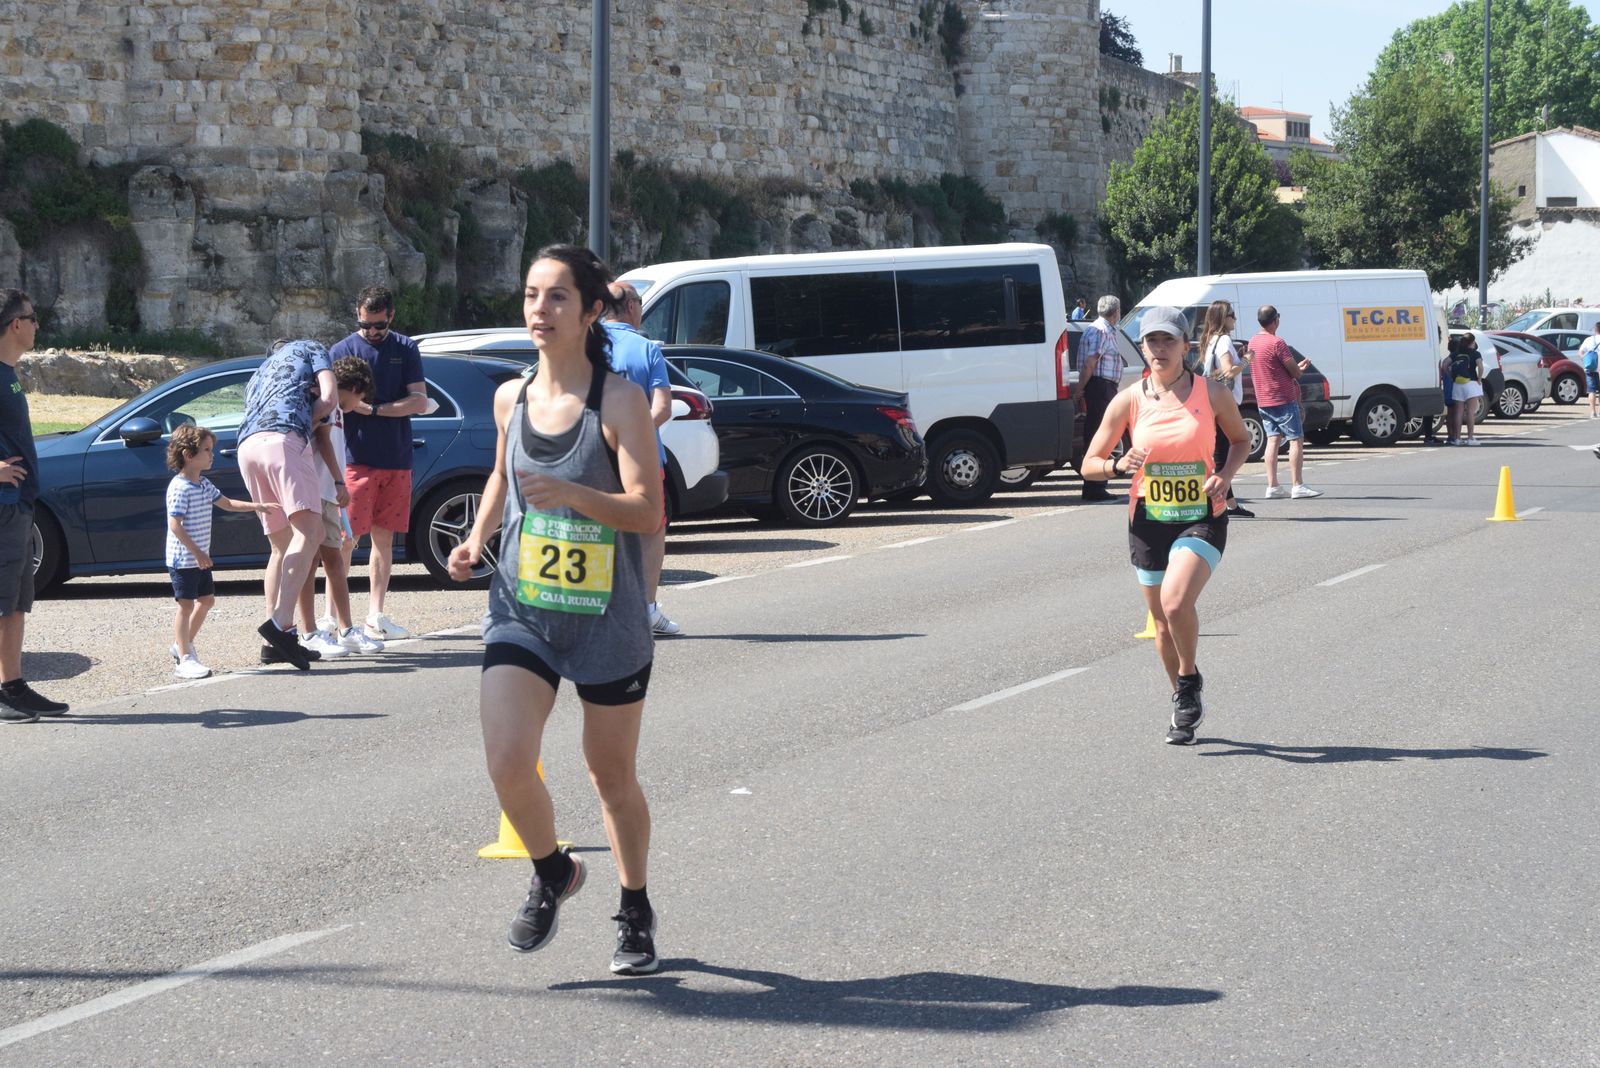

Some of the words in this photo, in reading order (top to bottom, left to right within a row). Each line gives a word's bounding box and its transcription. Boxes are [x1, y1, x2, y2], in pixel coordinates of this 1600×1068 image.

[1150, 480, 1199, 502] 0968
[547, 529, 568, 540] CAJA
[569, 533, 601, 542] RURAL
[540, 545, 587, 583] 23
[540, 591, 566, 604] CAJA
[567, 595, 604, 607] RURAL
